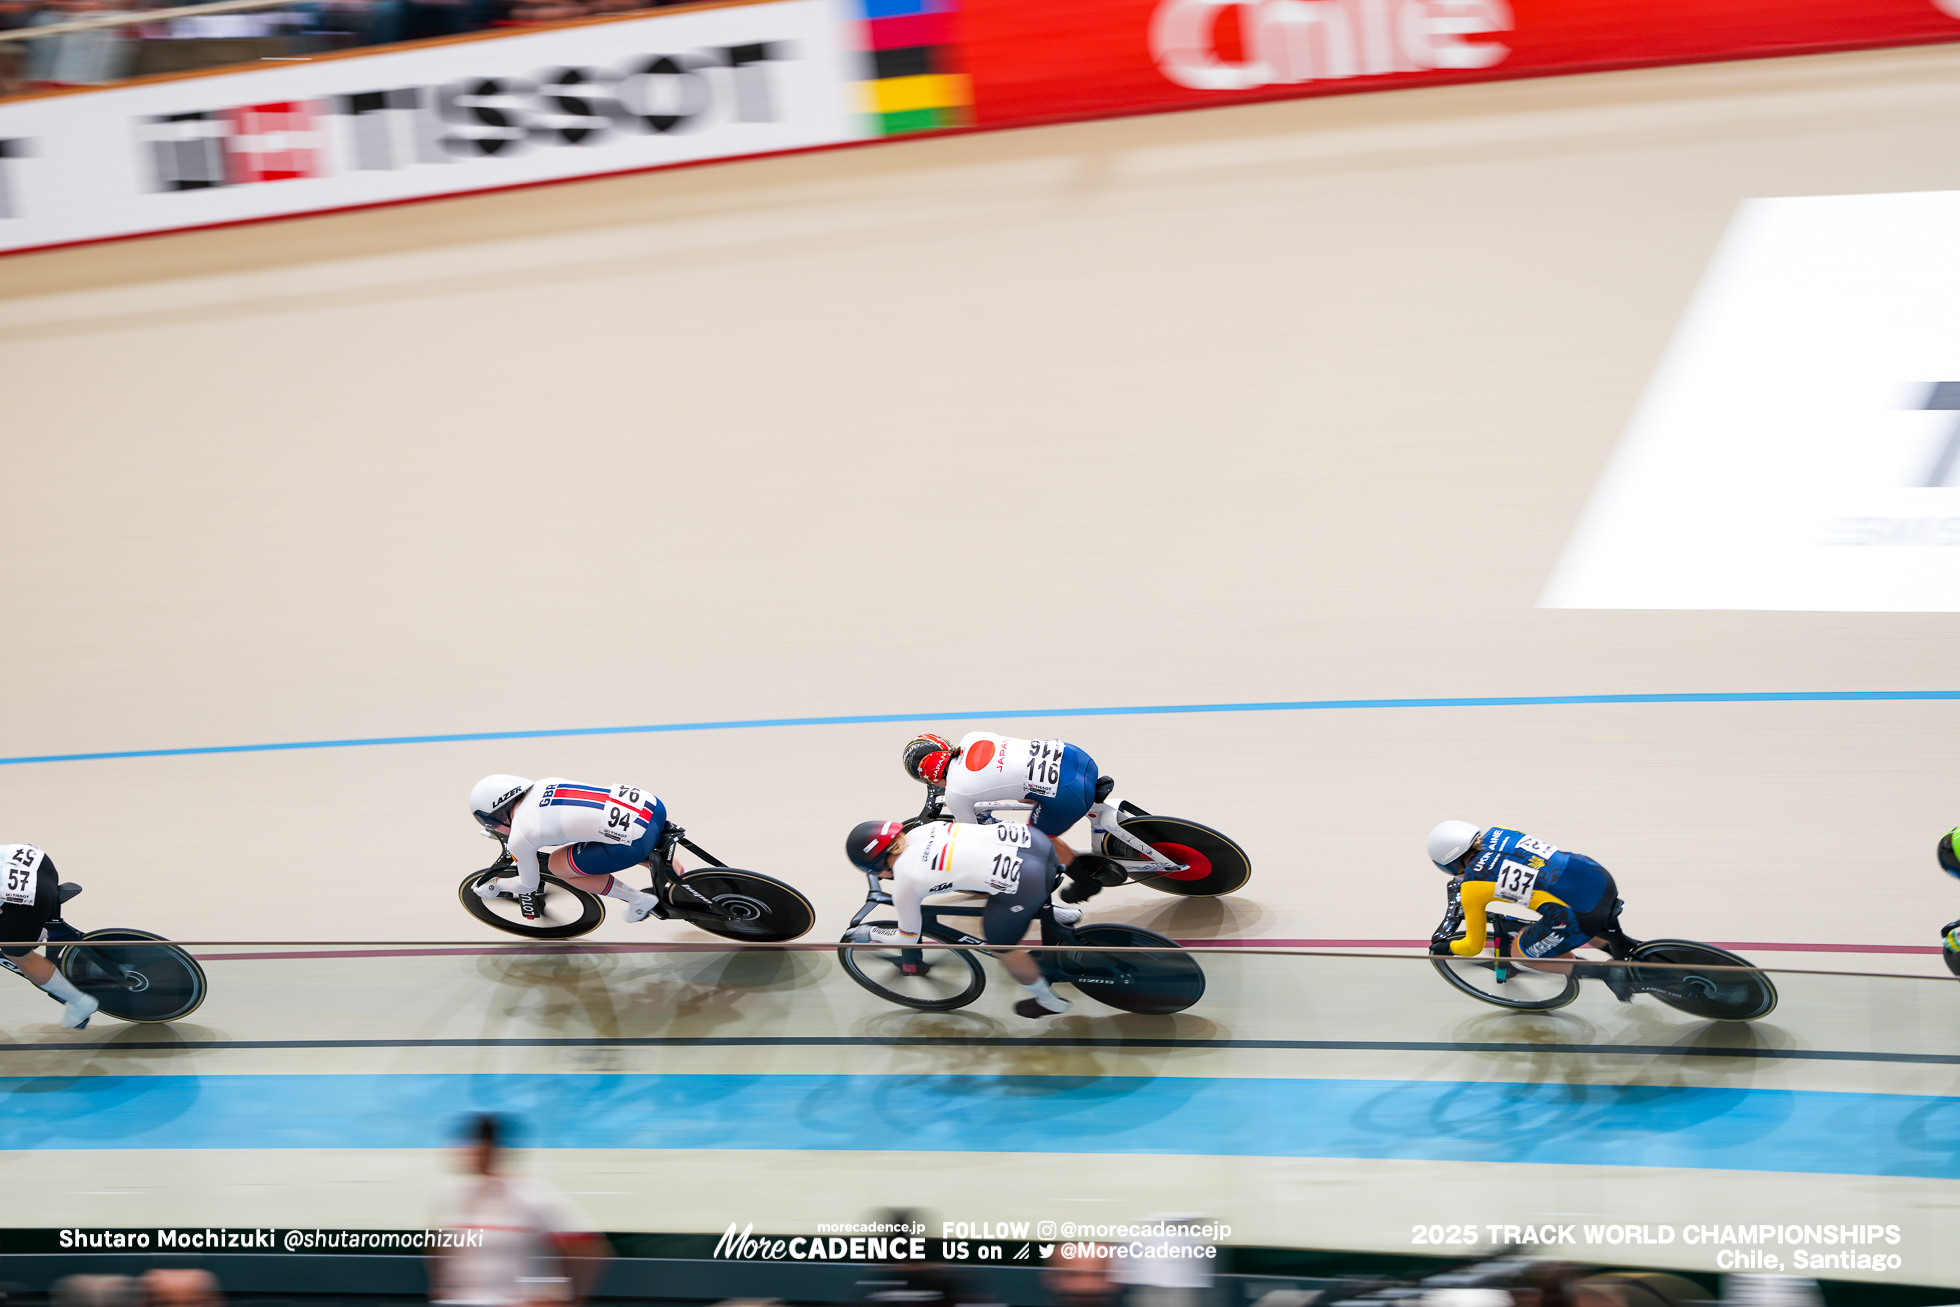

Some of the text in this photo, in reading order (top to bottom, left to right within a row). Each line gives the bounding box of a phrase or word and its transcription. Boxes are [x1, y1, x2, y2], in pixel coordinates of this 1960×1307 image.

[336, 39, 794, 171] TISSOT
[933, 752, 947, 778] JAPAN
[1026, 758, 1059, 785] 116
[492, 785, 523, 809] LAZER
[539, 783, 557, 807] GBR
[608, 806, 631, 832] 94
[1473, 829, 1504, 873] UKRAINE
[7, 868, 30, 891] 57
[992, 853, 1021, 882] 100
[1500, 865, 1535, 895] 137
[929, 881, 954, 893] KTM
